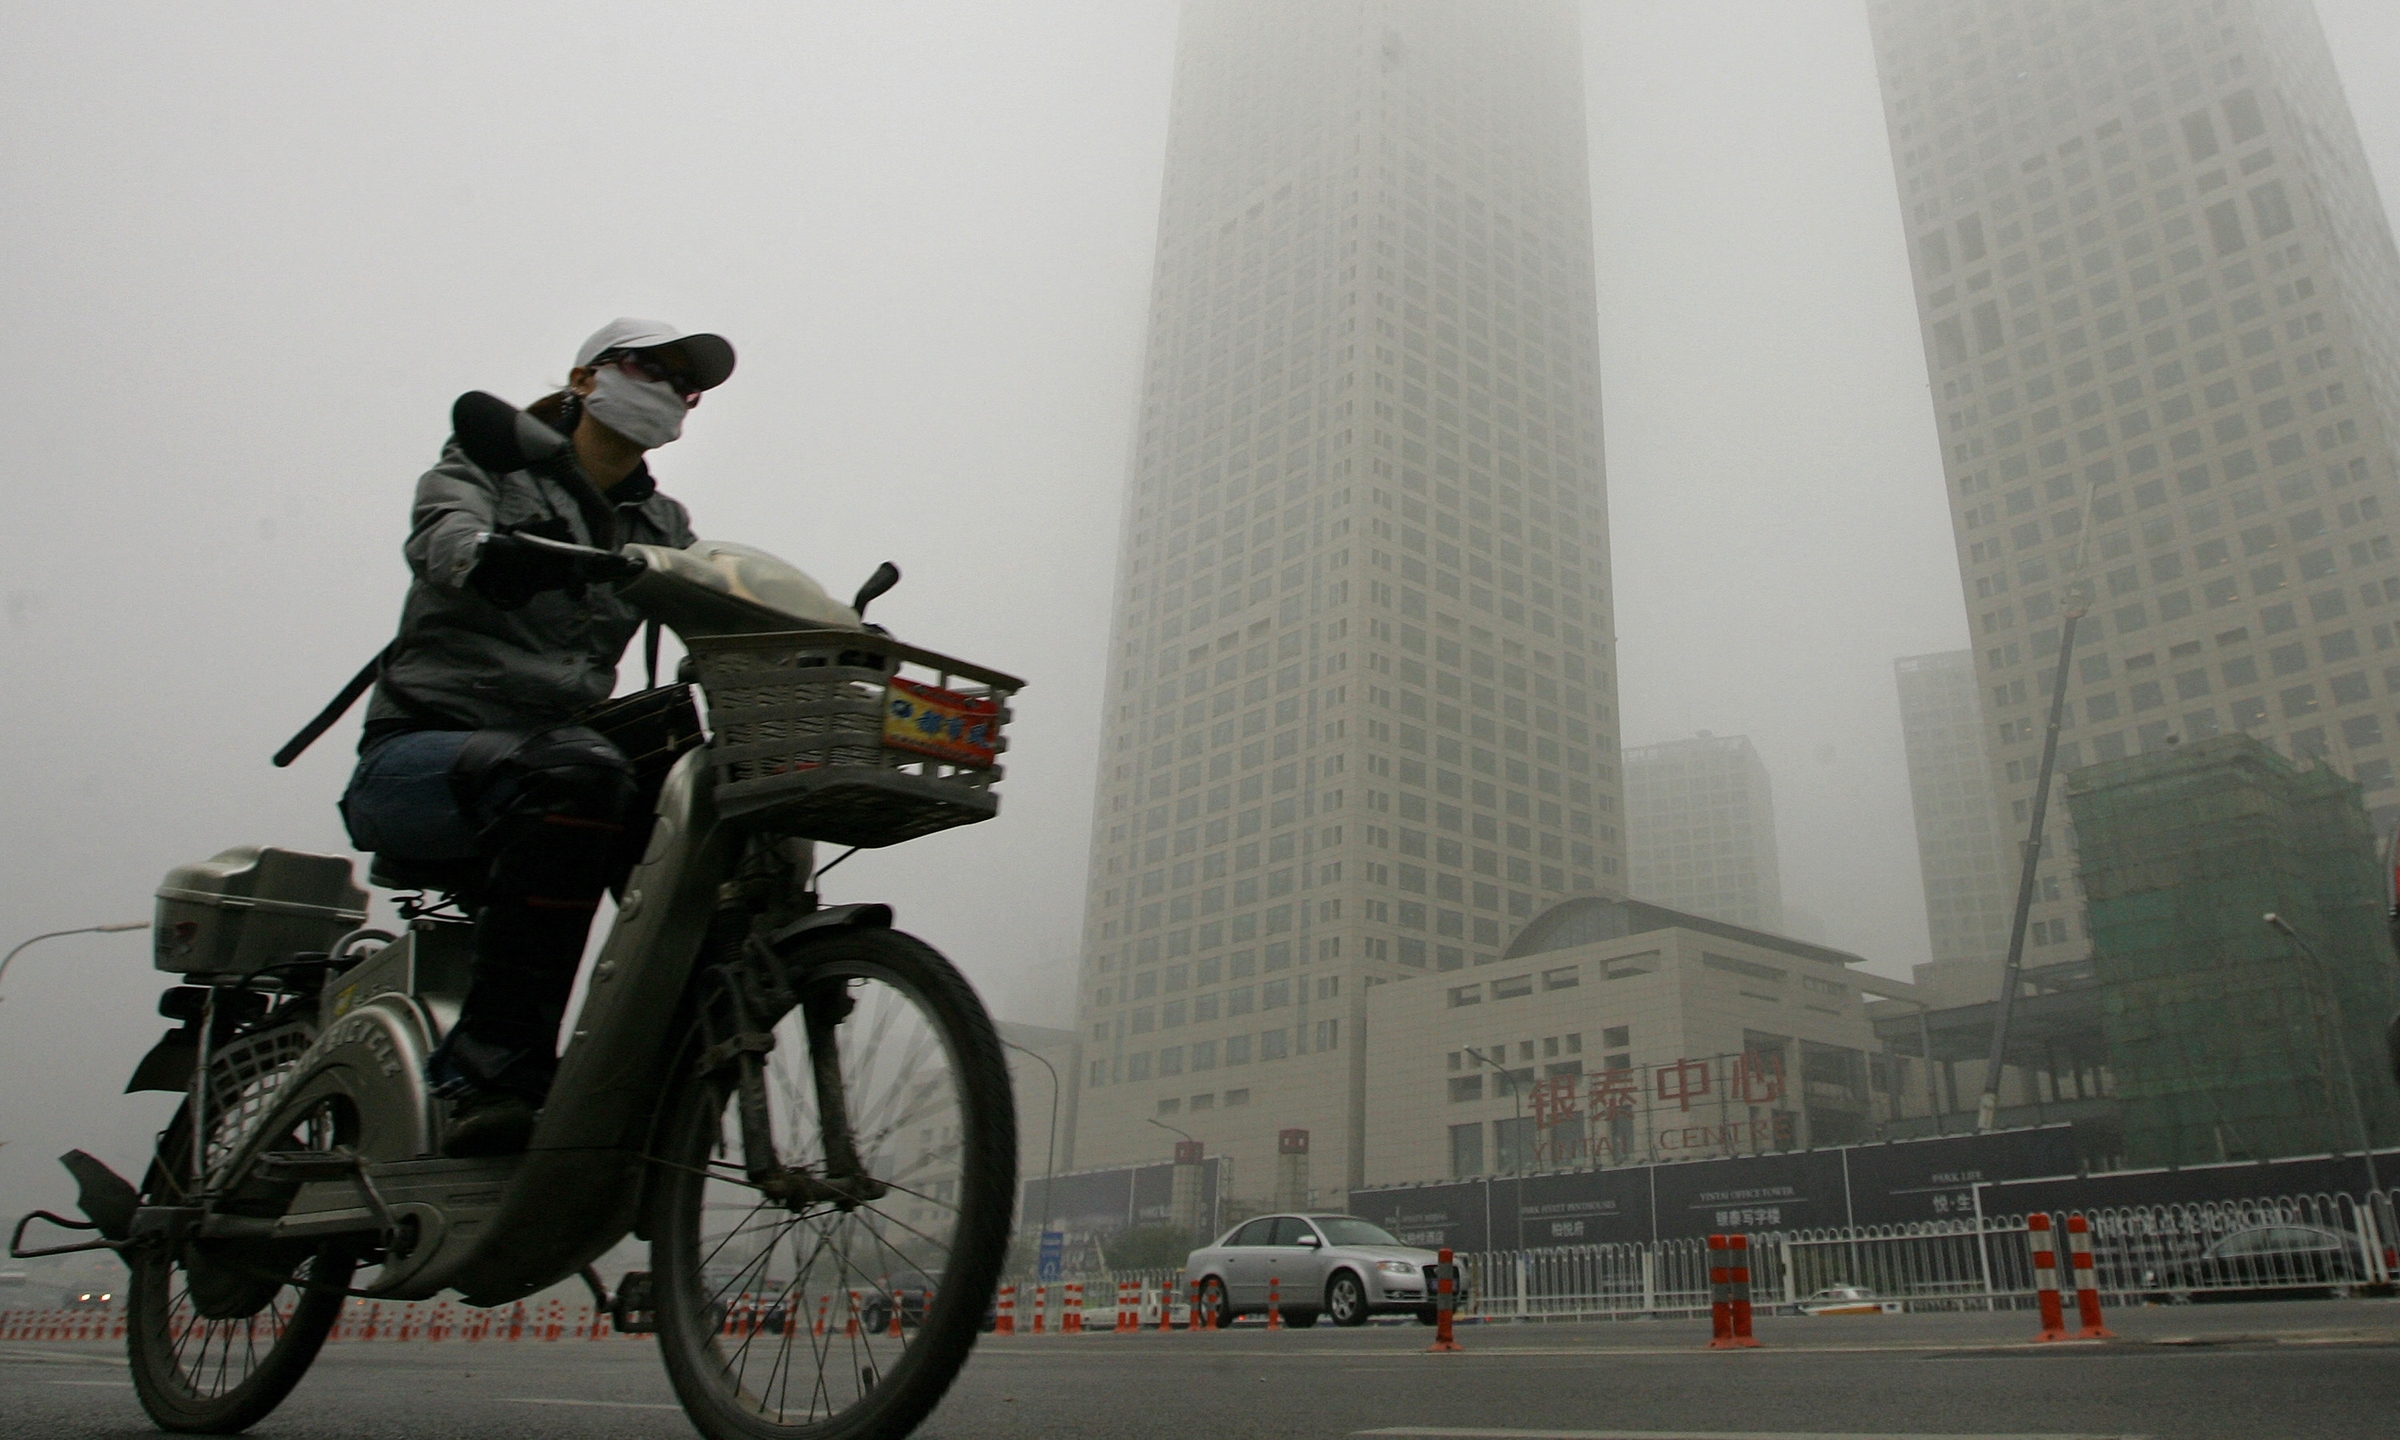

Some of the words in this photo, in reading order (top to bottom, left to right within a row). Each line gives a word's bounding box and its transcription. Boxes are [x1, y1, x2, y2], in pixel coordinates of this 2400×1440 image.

[1527, 1048, 1787, 1131] 银泰中心
[1659, 1115, 1794, 1150] CENTRE
